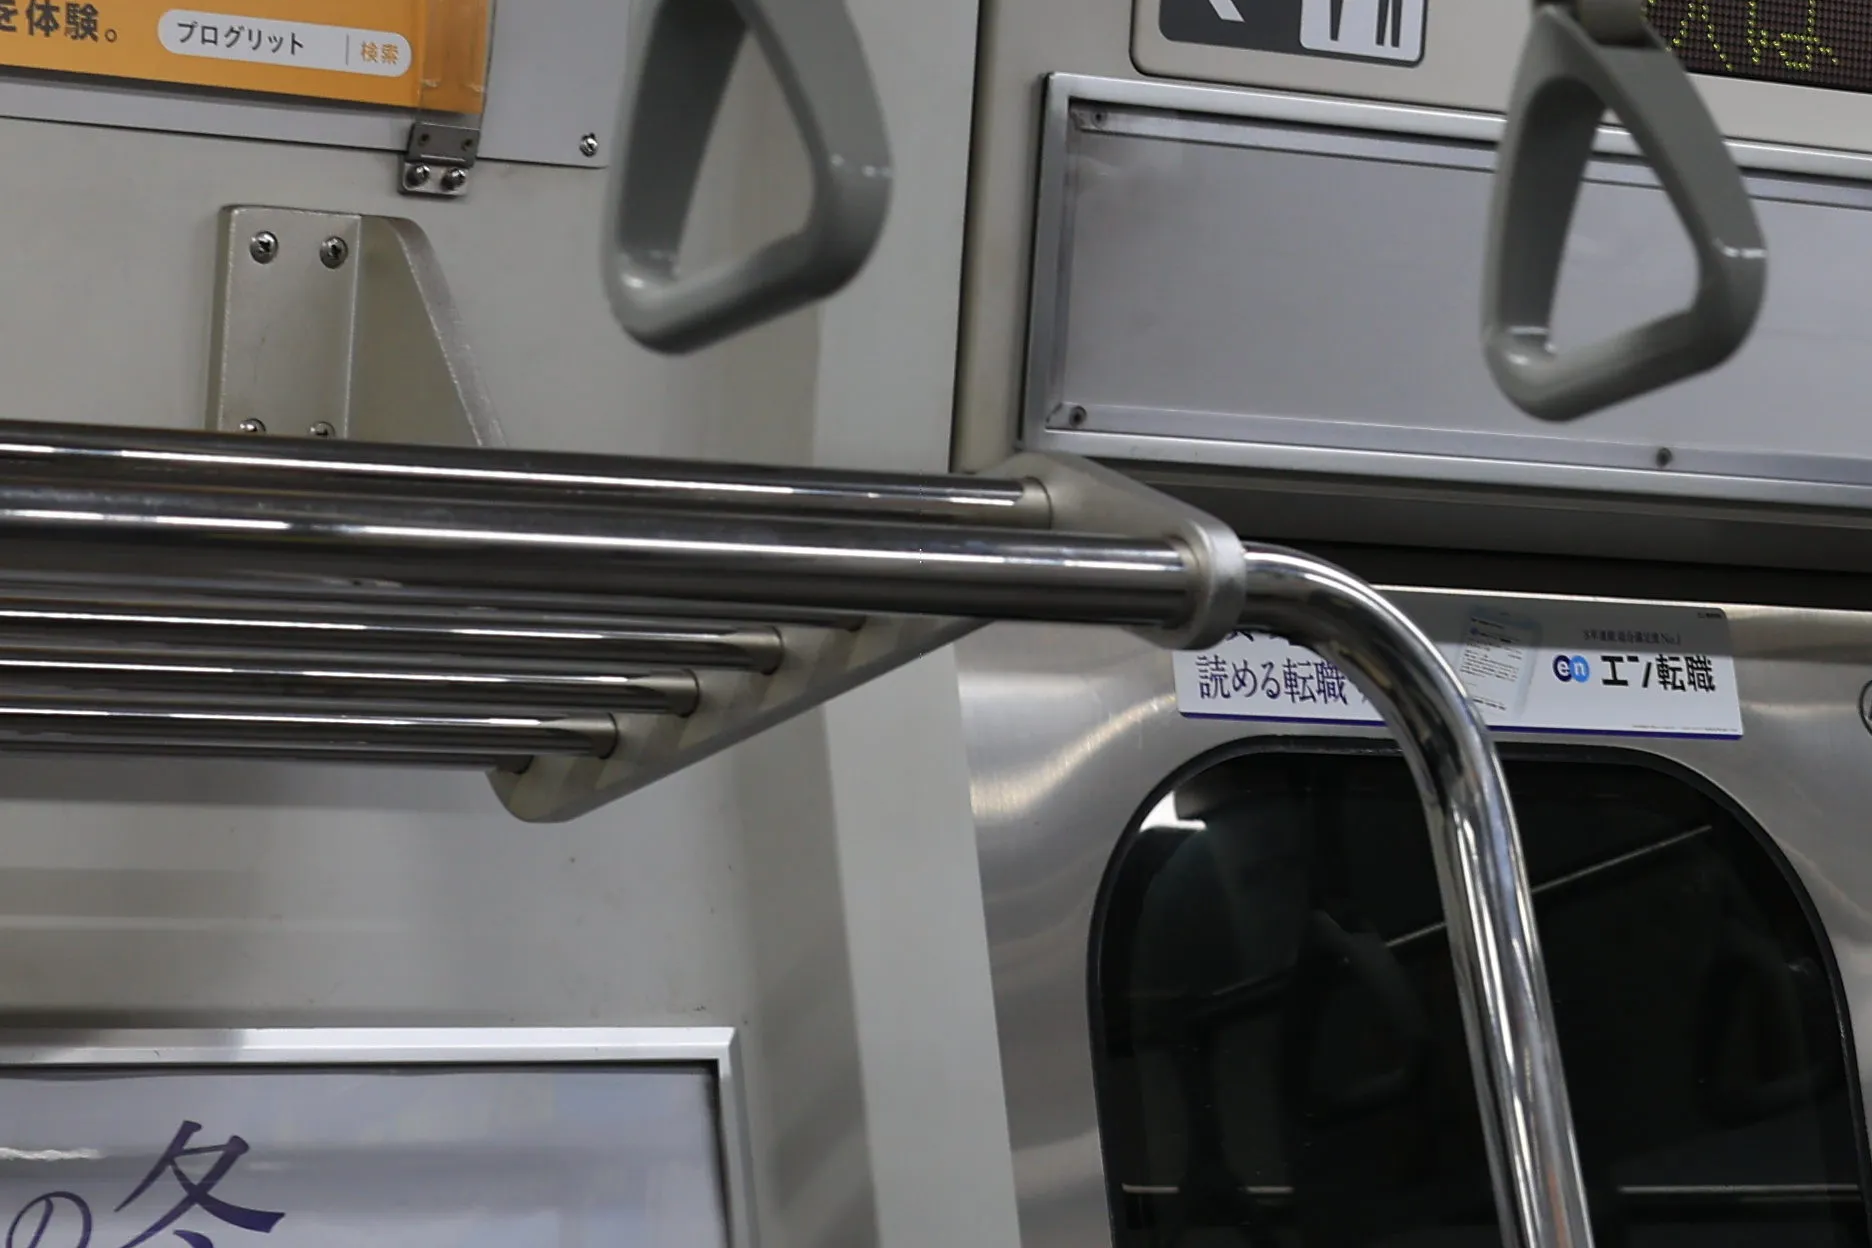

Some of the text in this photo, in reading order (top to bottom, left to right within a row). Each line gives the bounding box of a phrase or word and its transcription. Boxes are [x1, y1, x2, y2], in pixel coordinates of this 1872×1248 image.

[176, 20, 400, 67] プログリット 検索
[1553, 654, 1591, 684] en
[1600, 653, 1717, 693] エン転職
